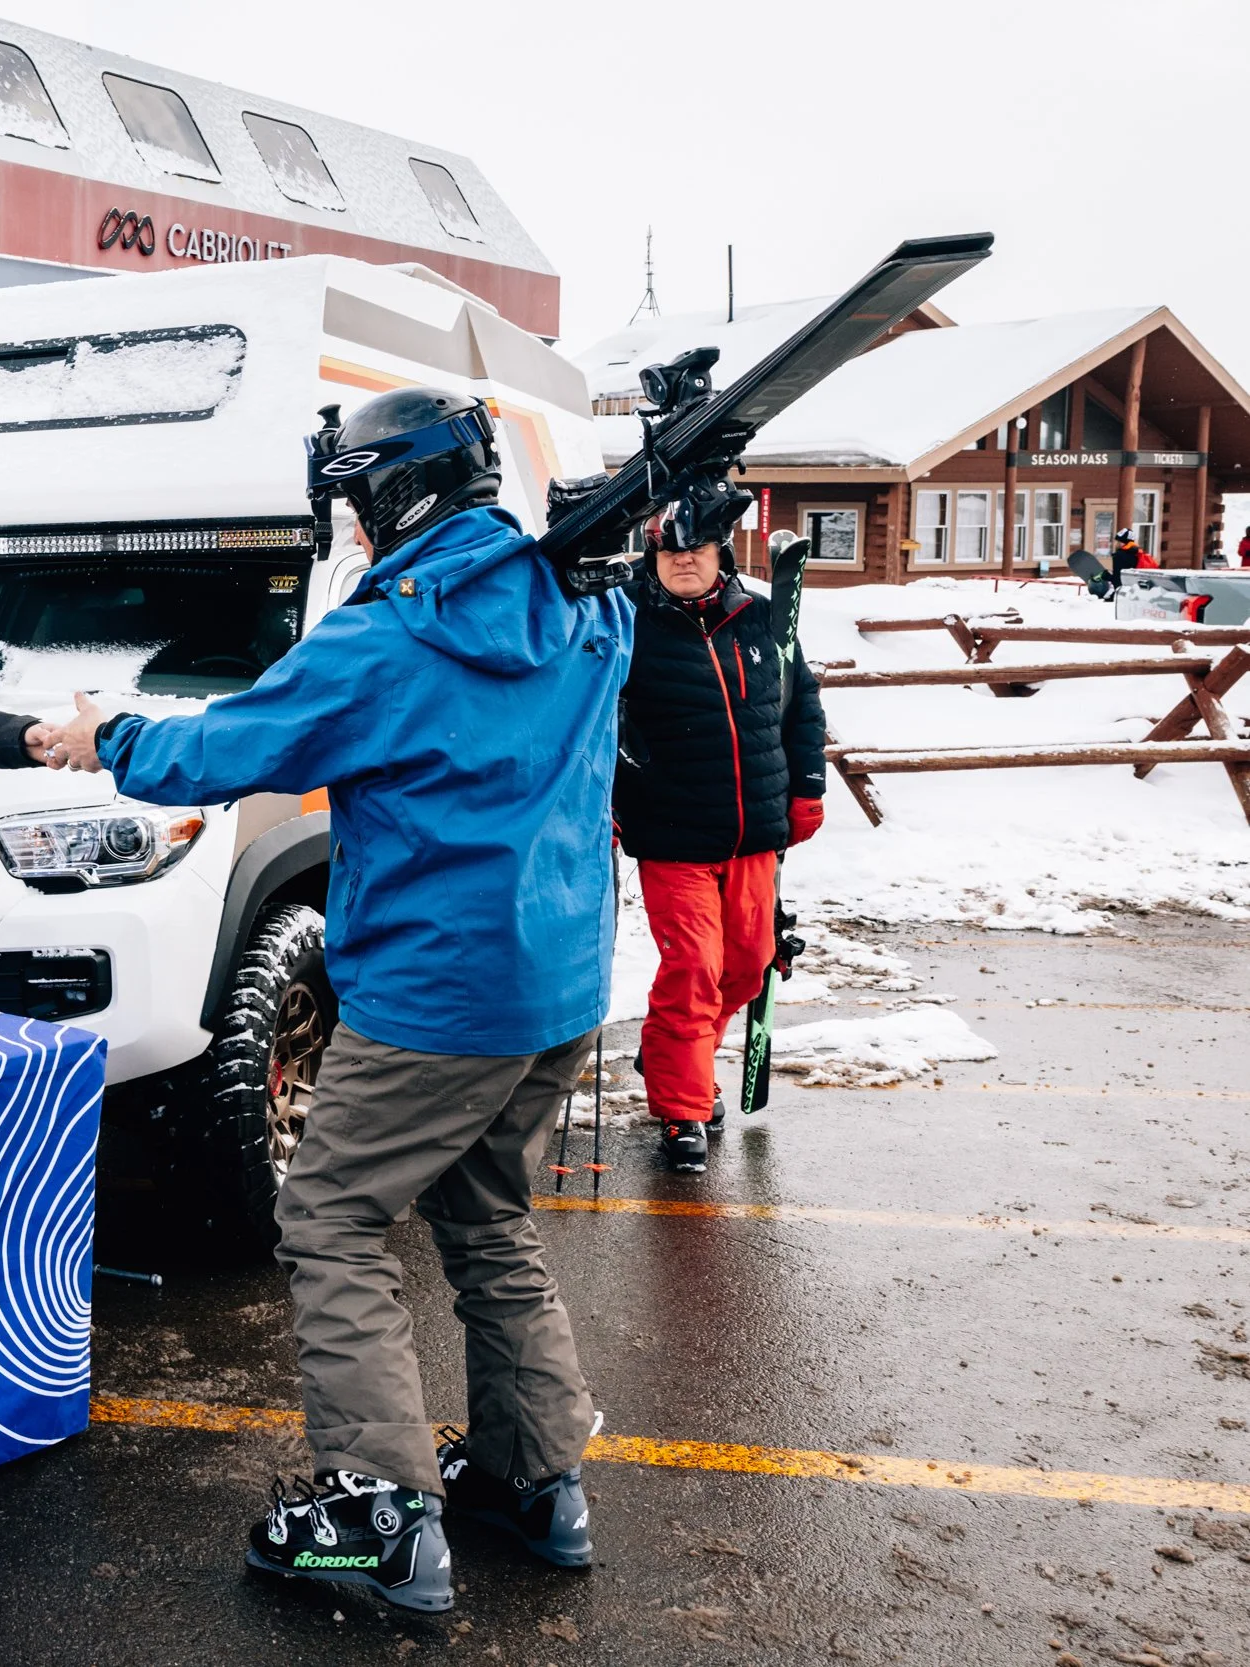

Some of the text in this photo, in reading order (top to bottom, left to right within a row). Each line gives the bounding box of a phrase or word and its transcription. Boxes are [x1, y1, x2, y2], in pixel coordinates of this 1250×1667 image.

[1031, 453, 1108, 465] SEASON PASS
[1154, 453, 1183, 464] TICKETS
[293, 1551, 379, 1568] NORDICA
